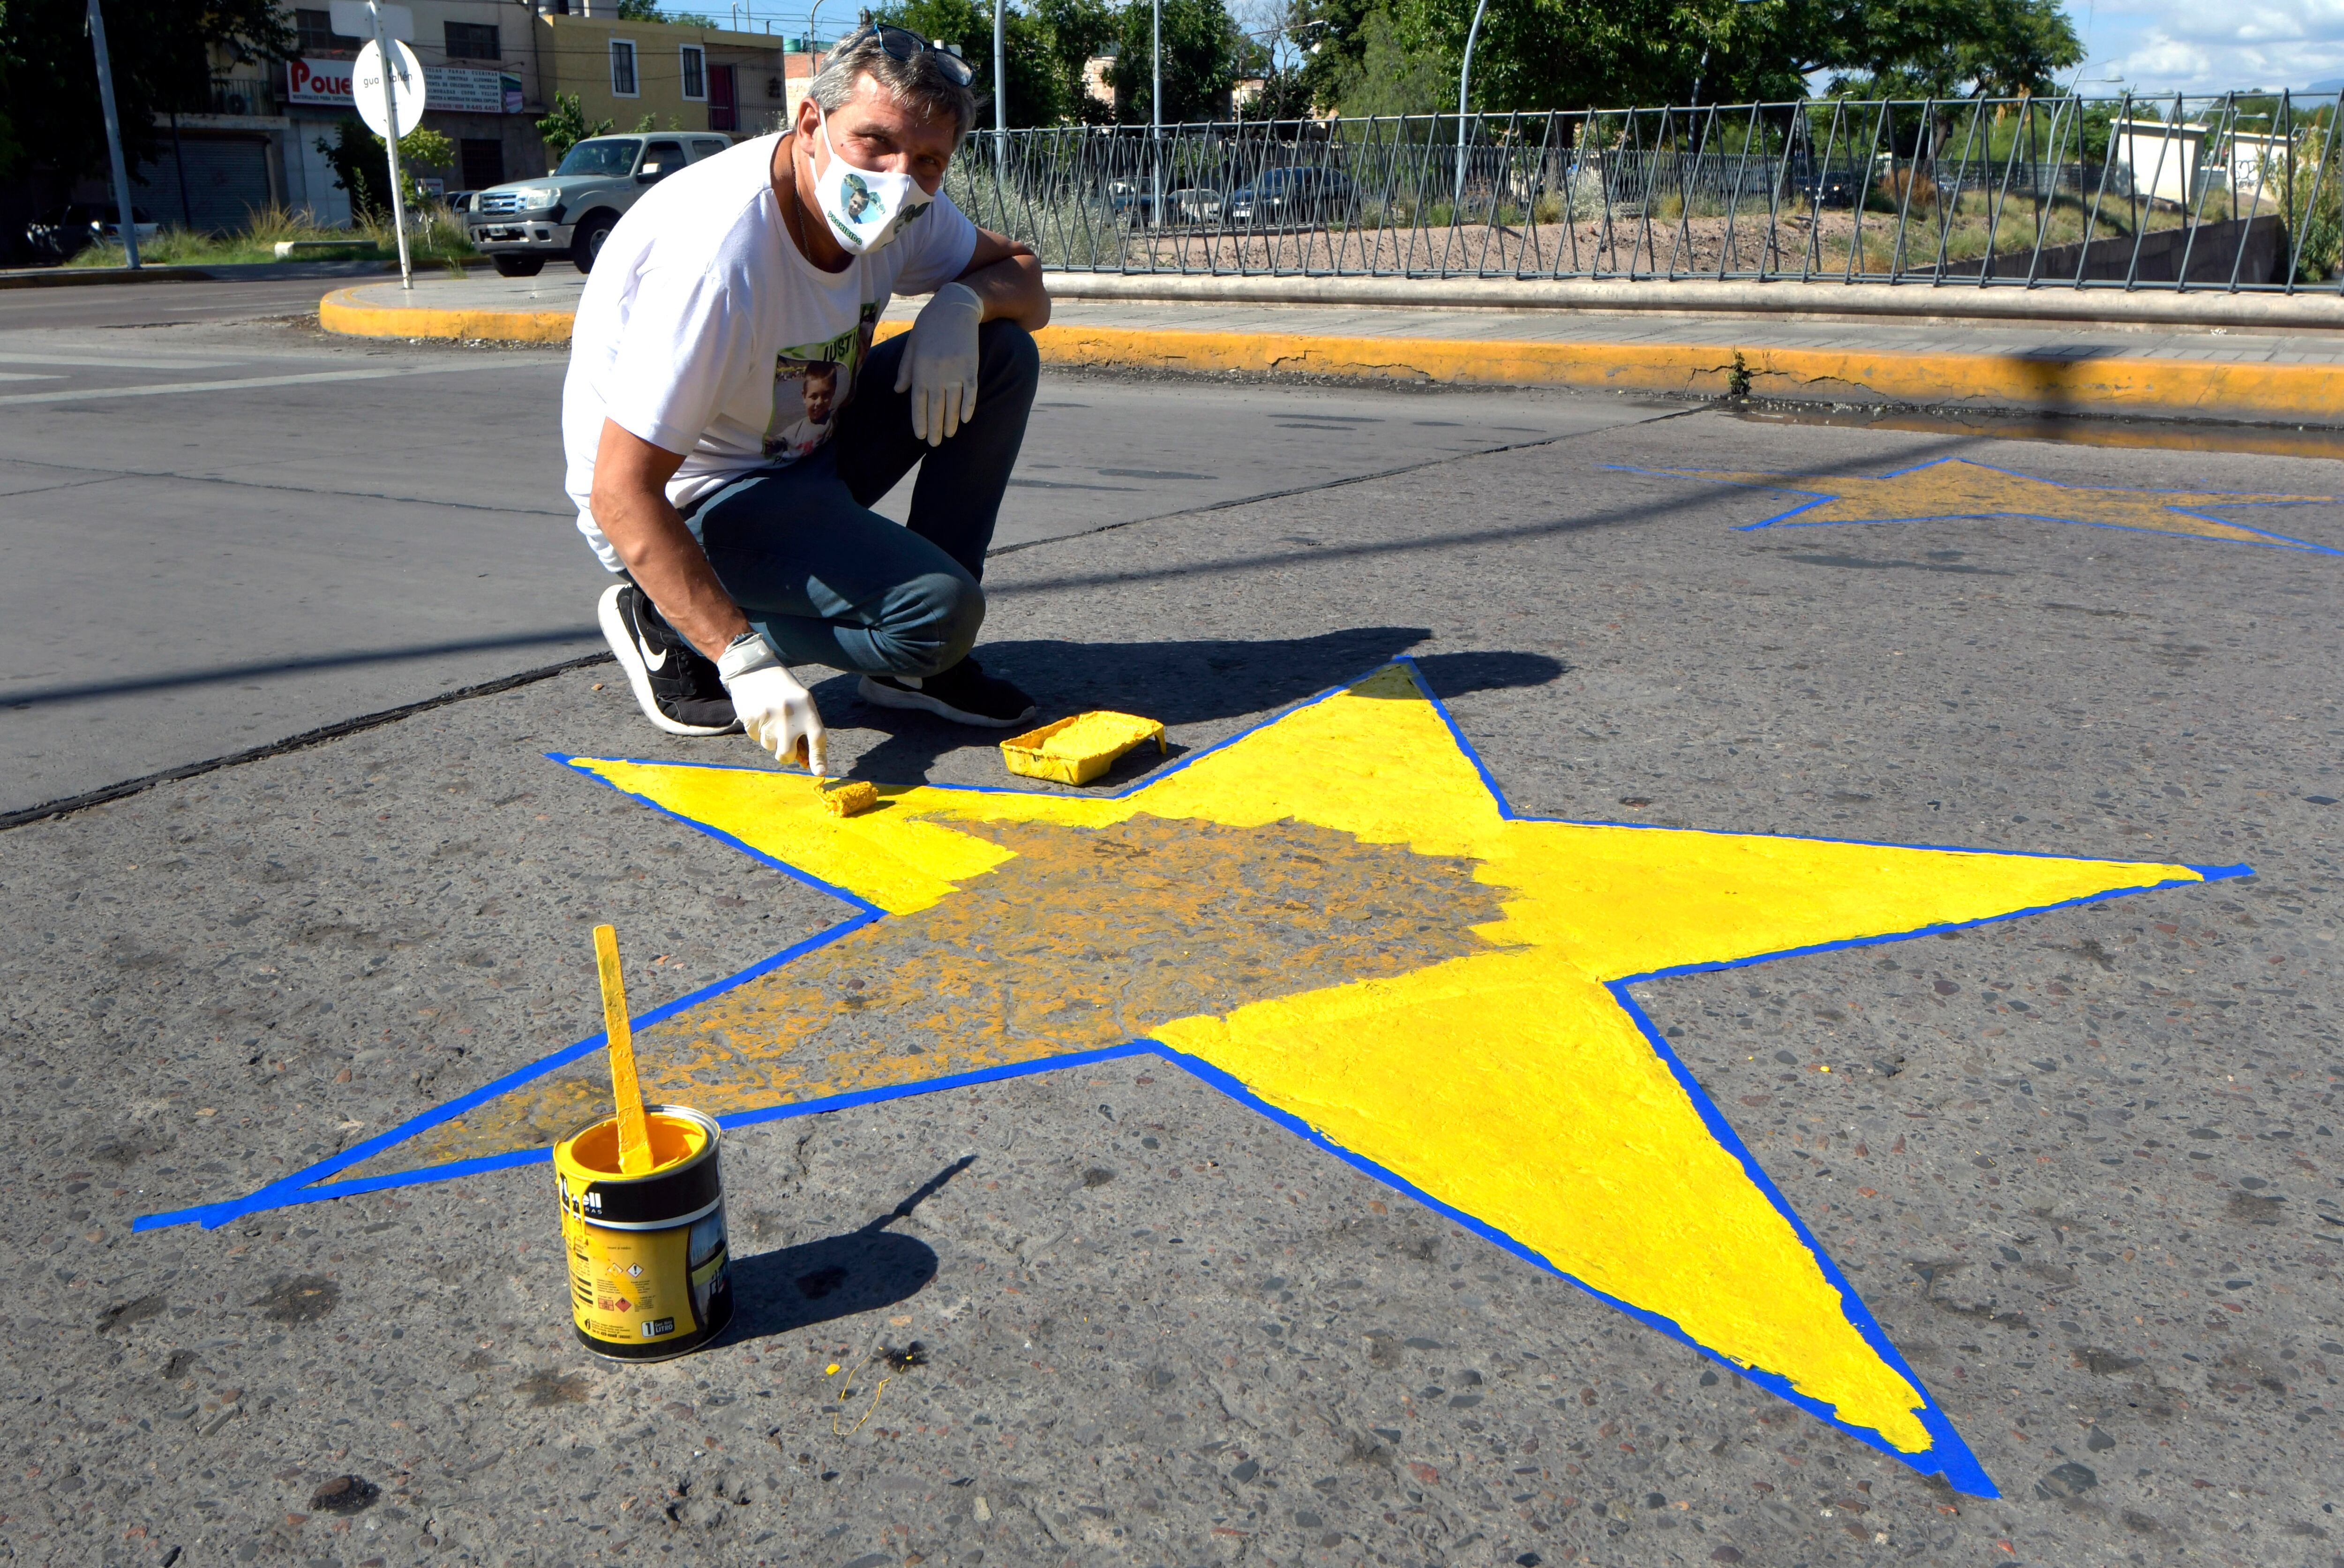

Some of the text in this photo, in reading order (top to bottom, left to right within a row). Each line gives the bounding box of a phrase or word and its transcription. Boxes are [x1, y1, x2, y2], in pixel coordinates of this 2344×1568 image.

[827, 210, 862, 245] PROHIBIDO
[645, 1322, 651, 1335] 1
[656, 1324, 673, 1333] LITRO
